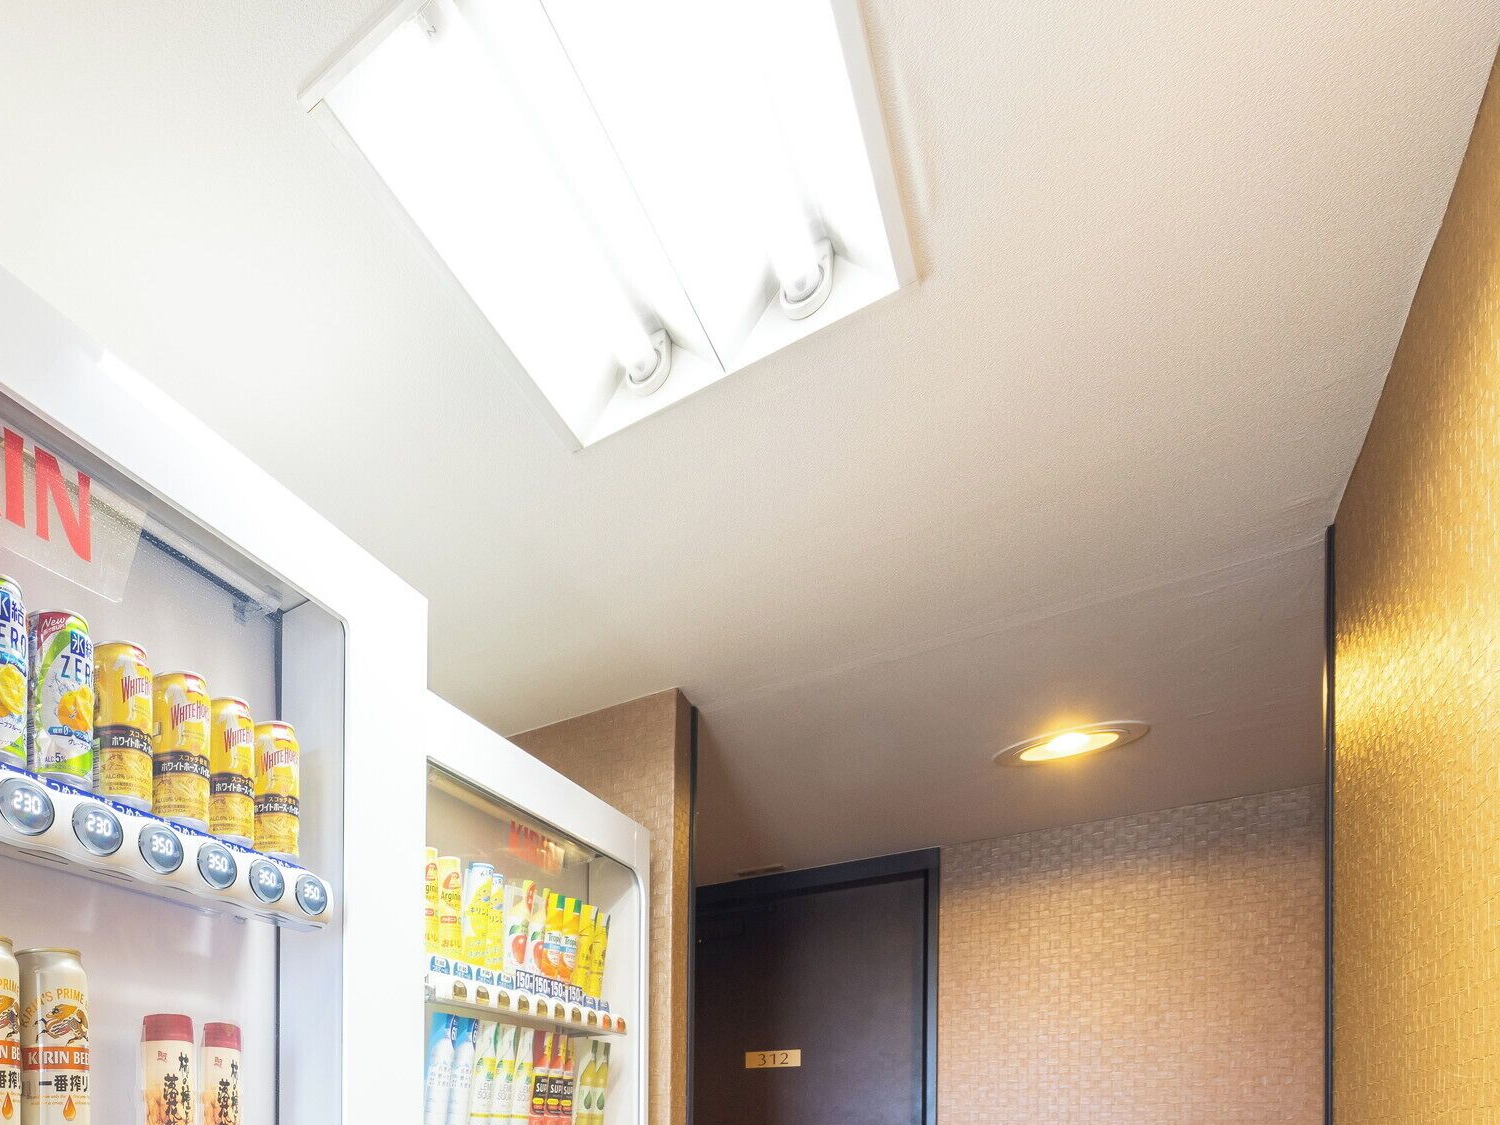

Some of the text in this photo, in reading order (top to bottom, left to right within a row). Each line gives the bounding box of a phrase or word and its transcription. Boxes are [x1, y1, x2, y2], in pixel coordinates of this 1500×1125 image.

[42, 617, 66, 630] New
[13, 789, 41, 815] 230
[86, 813, 112, 836] 230
[152, 836, 172, 856] 350
[208, 854, 228, 873] 350
[258, 870, 276, 888] 350
[303, 884, 320, 901] 350
[57, 987, 84, 1004] PRIME
[757, 1052, 789, 1066] 312
[39, 1075, 88, 1092] 一番搾り
